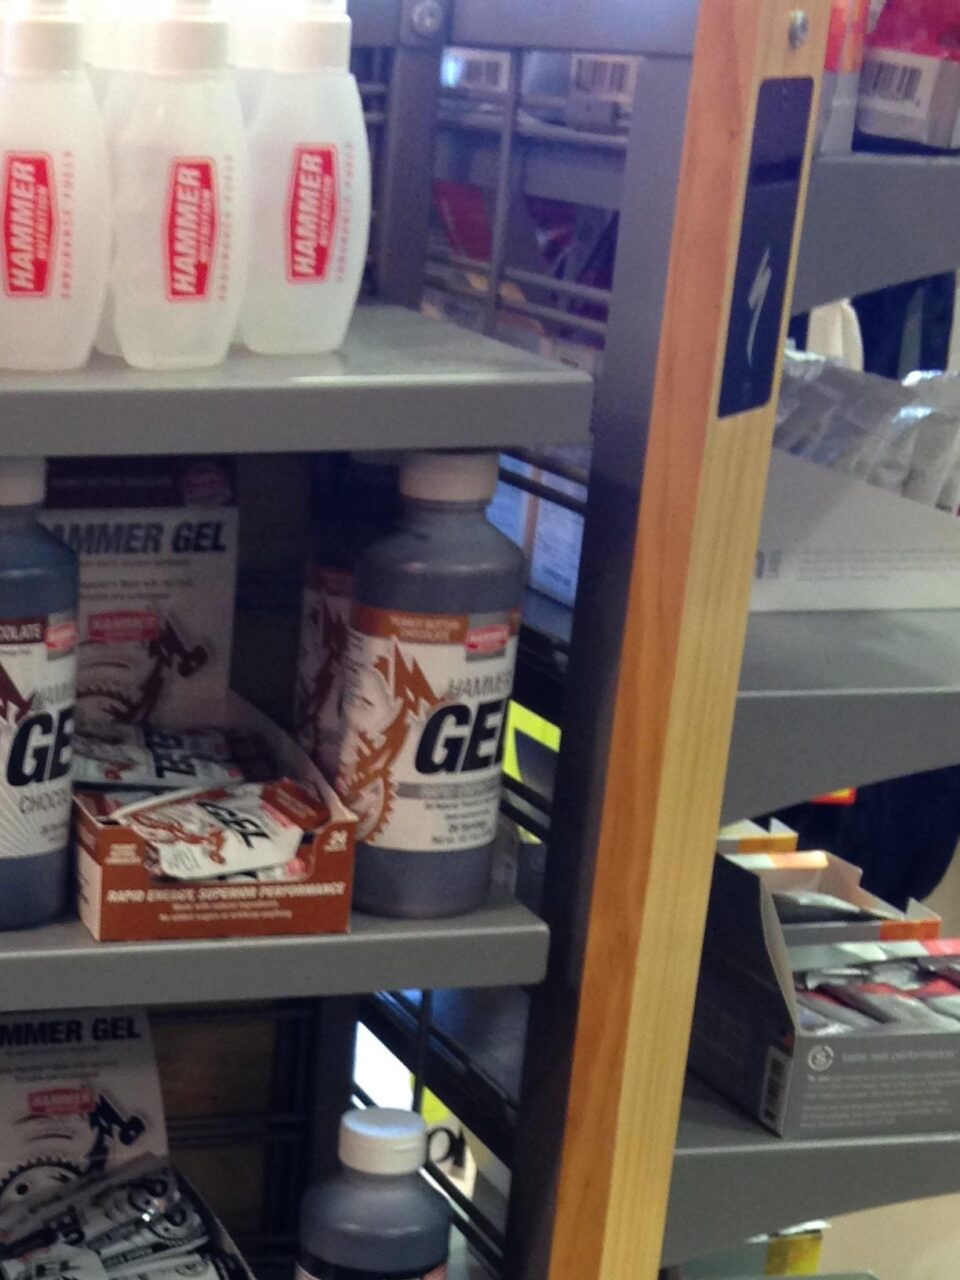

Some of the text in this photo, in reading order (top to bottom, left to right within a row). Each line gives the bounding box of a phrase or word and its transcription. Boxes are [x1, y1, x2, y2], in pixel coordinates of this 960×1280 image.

[11, 160, 36, 290] HAMMER
[172, 166, 201, 294] HAMMER
[293, 153, 323, 276] HAMMER
[173, 520, 227, 553] GEL
[6, 706, 73, 787] GE
[91, 1017, 141, 1041] GEL
